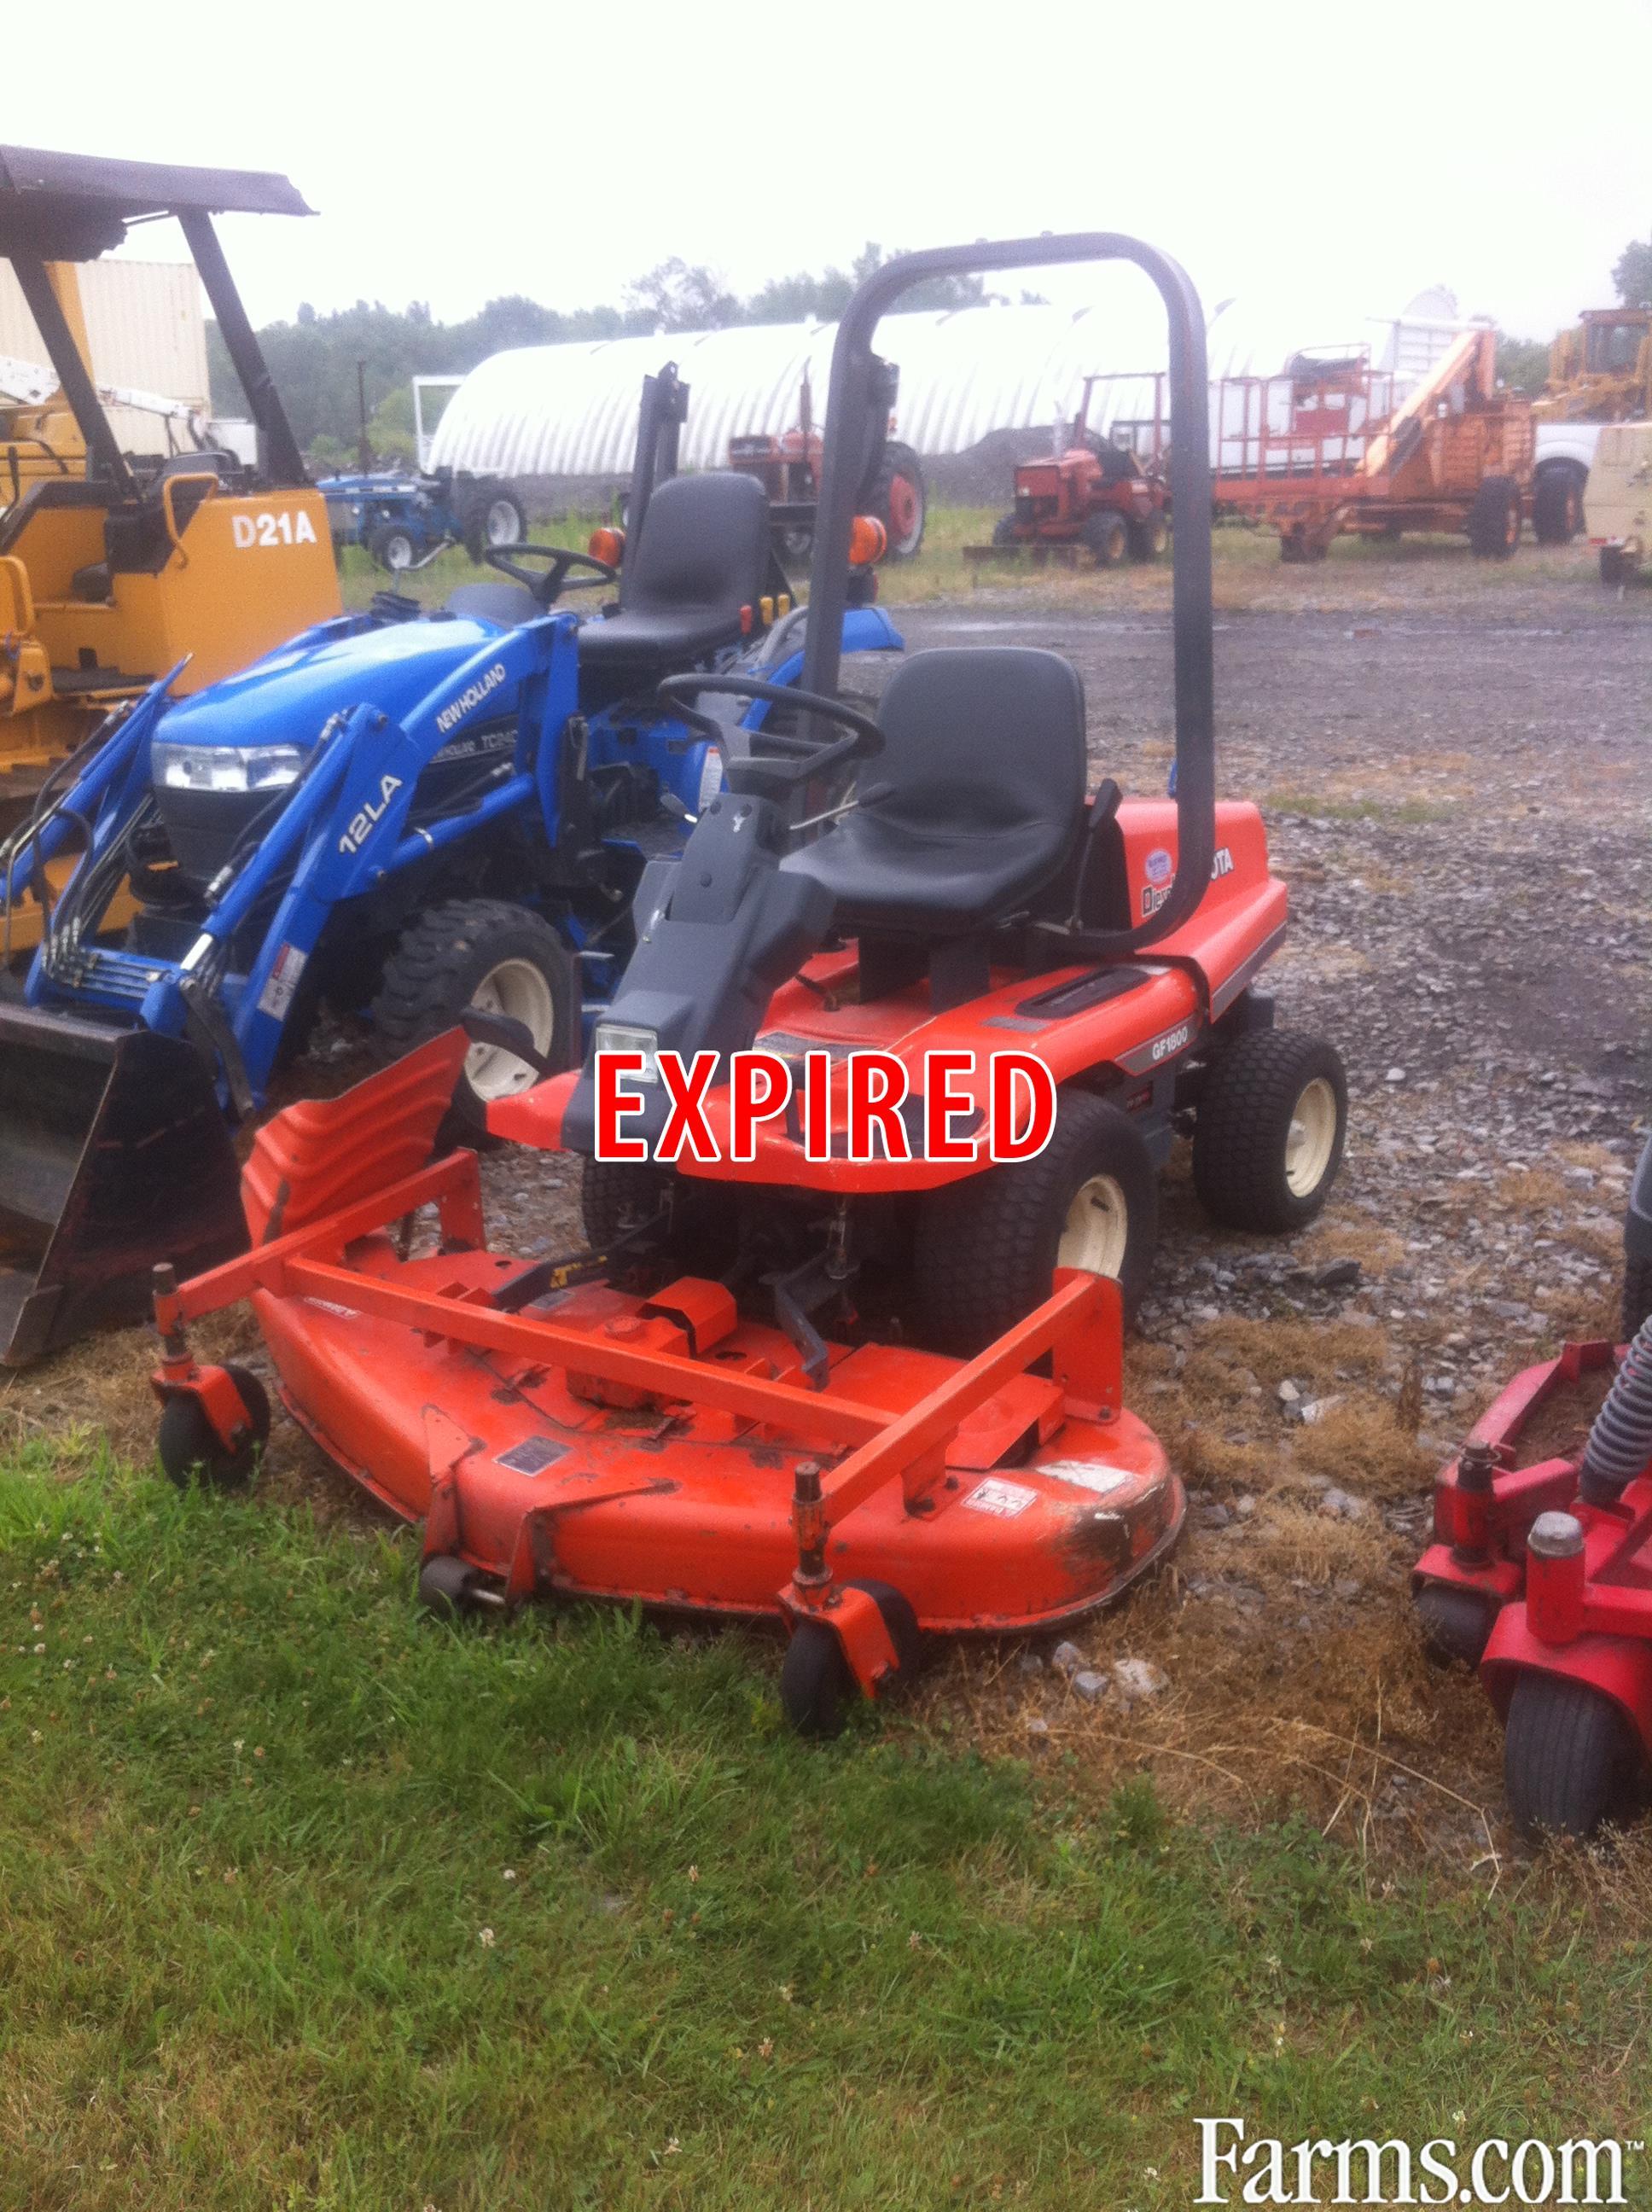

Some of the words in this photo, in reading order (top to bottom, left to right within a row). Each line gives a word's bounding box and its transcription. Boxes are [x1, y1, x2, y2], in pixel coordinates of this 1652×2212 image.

[231, 510, 317, 548] D21A
[339, 775, 403, 853] 12LA
[1152, 1026, 1189, 1060] GF1800
